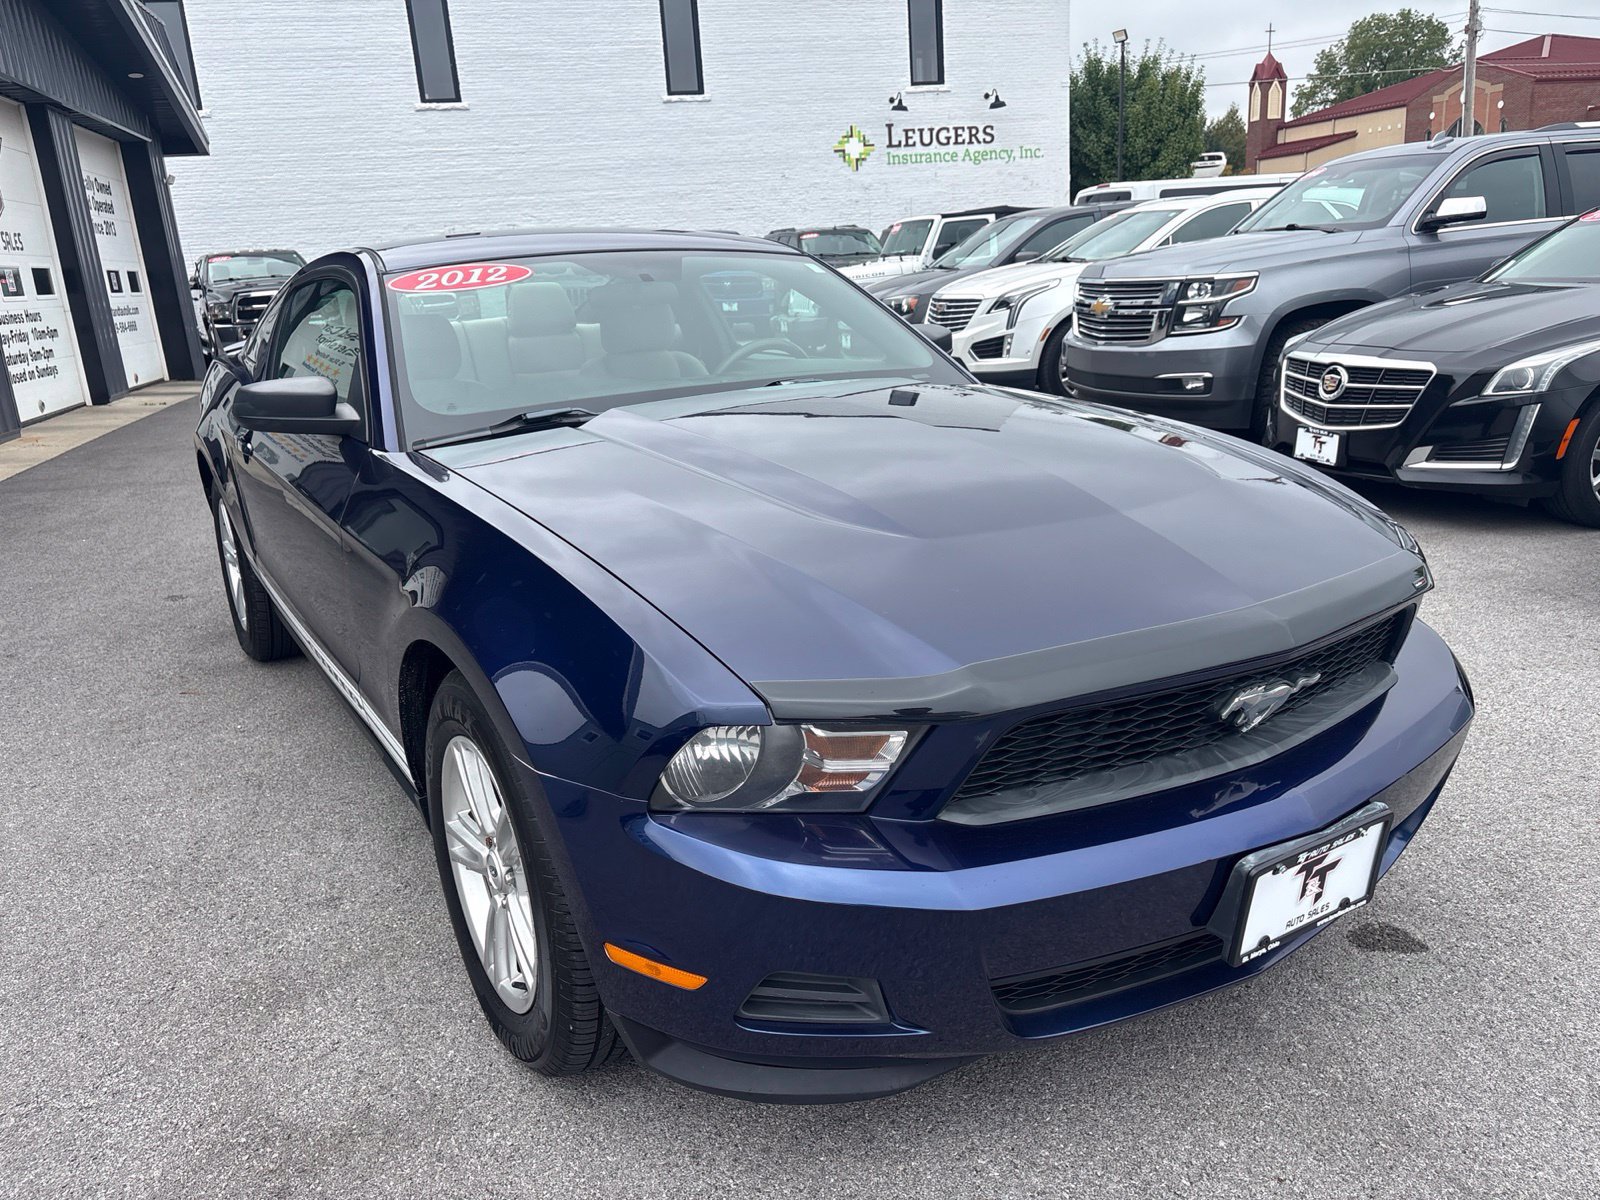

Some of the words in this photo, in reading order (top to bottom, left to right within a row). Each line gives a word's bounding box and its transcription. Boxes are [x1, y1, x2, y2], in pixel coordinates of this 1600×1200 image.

[885, 123, 995, 148] LEUGERS
[886, 150, 958, 165] Insurance
[961, 147, 1016, 165] Agency,
[1019, 145, 1045, 159] Inc.
[91, 195, 115, 215] Operated
[0, 230, 24, 252] SALES
[415, 265, 508, 290] 2012
[24, 308, 42, 323] Hours
[1, 329, 30, 349] ay-Friday
[31, 325, 59, 342] 10am-6pm
[5, 350, 30, 367] aturday
[29, 346, 55, 363] 9am-2pm
[9, 367, 28, 385] losed
[28, 369, 37, 381] on
[35, 363, 59, 379] Sundays
[1285, 913, 1306, 930] AUTO
[1306, 902, 1330, 920] SALES
